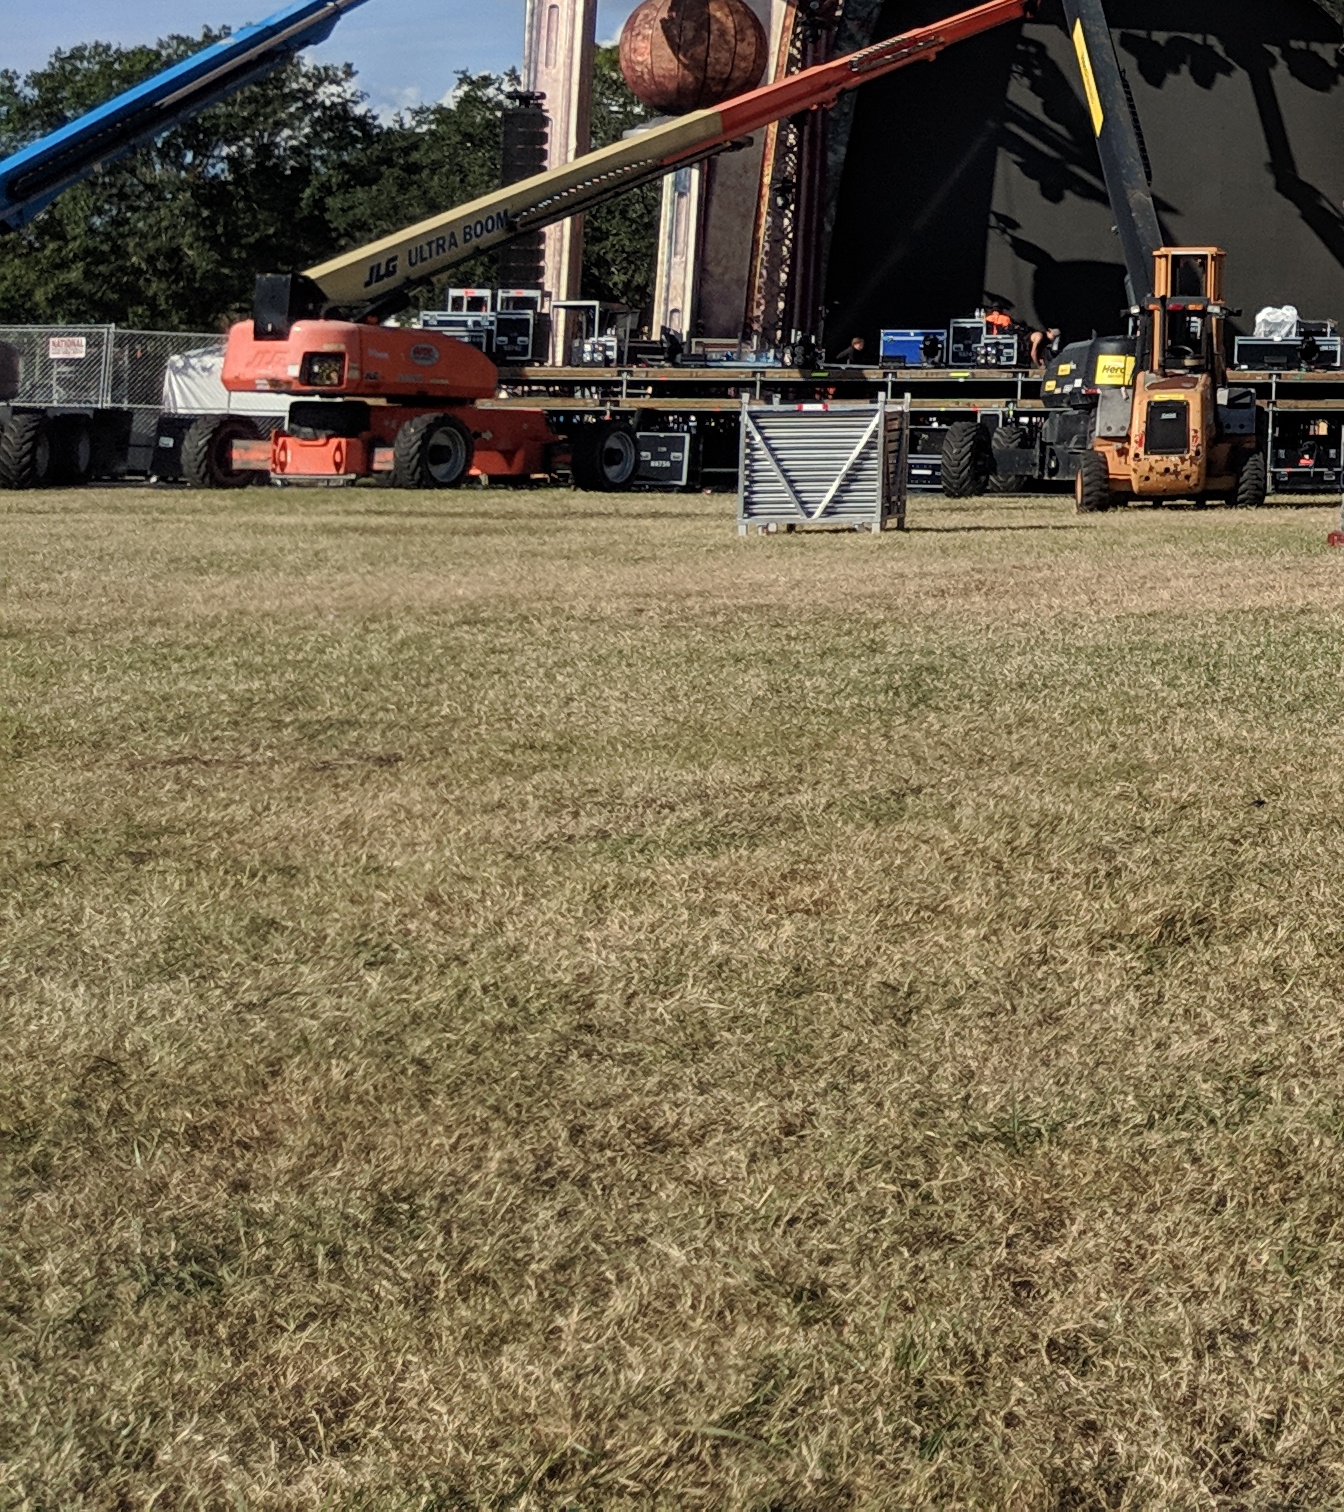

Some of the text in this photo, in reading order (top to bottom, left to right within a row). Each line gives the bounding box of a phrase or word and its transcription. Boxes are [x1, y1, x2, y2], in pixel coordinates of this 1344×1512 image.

[364, 209, 510, 288] JLG ULTRA BOOM
